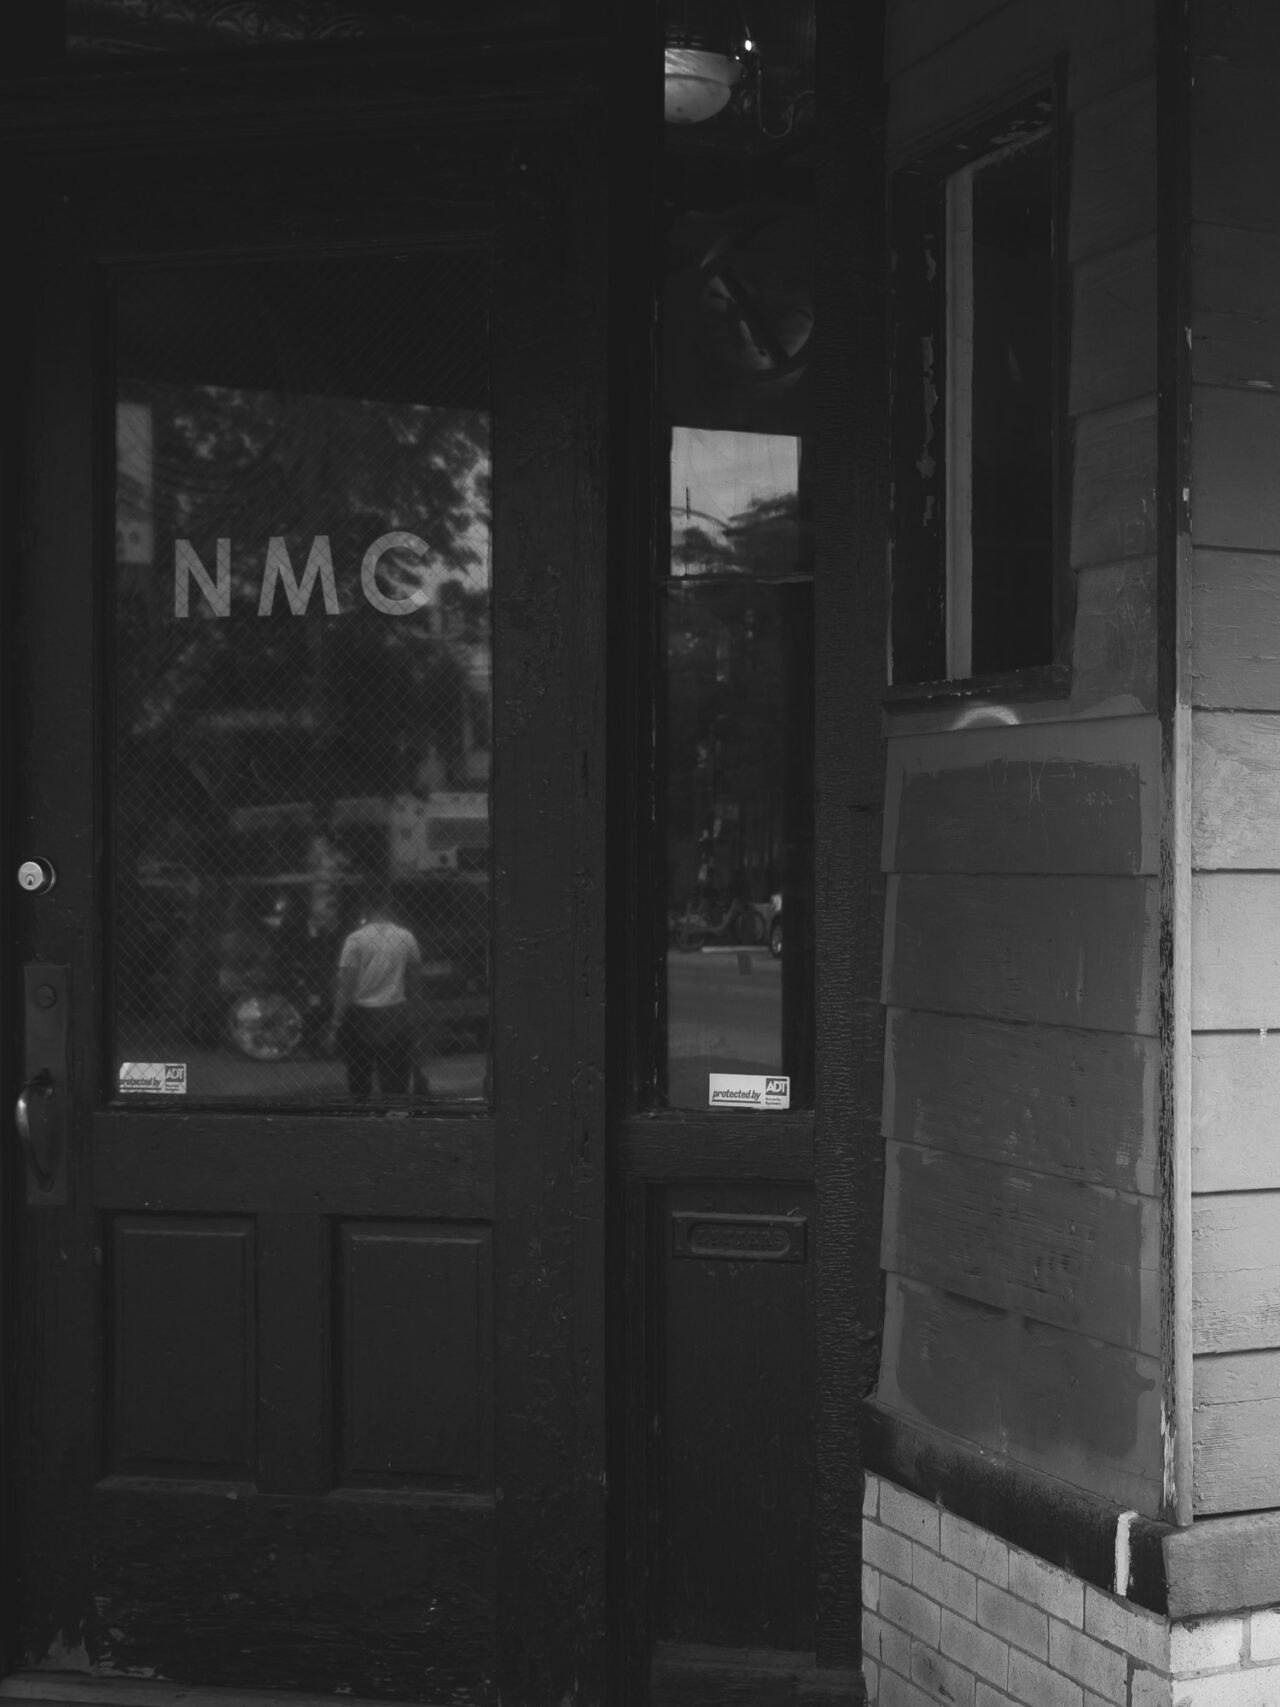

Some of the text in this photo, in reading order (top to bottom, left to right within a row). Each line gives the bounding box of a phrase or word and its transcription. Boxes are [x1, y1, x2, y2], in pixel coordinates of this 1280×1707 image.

[166, 1067, 184, 1080] ADT
[766, 1080, 787, 1093] ADT
[712, 1089, 761, 1101] protected by
